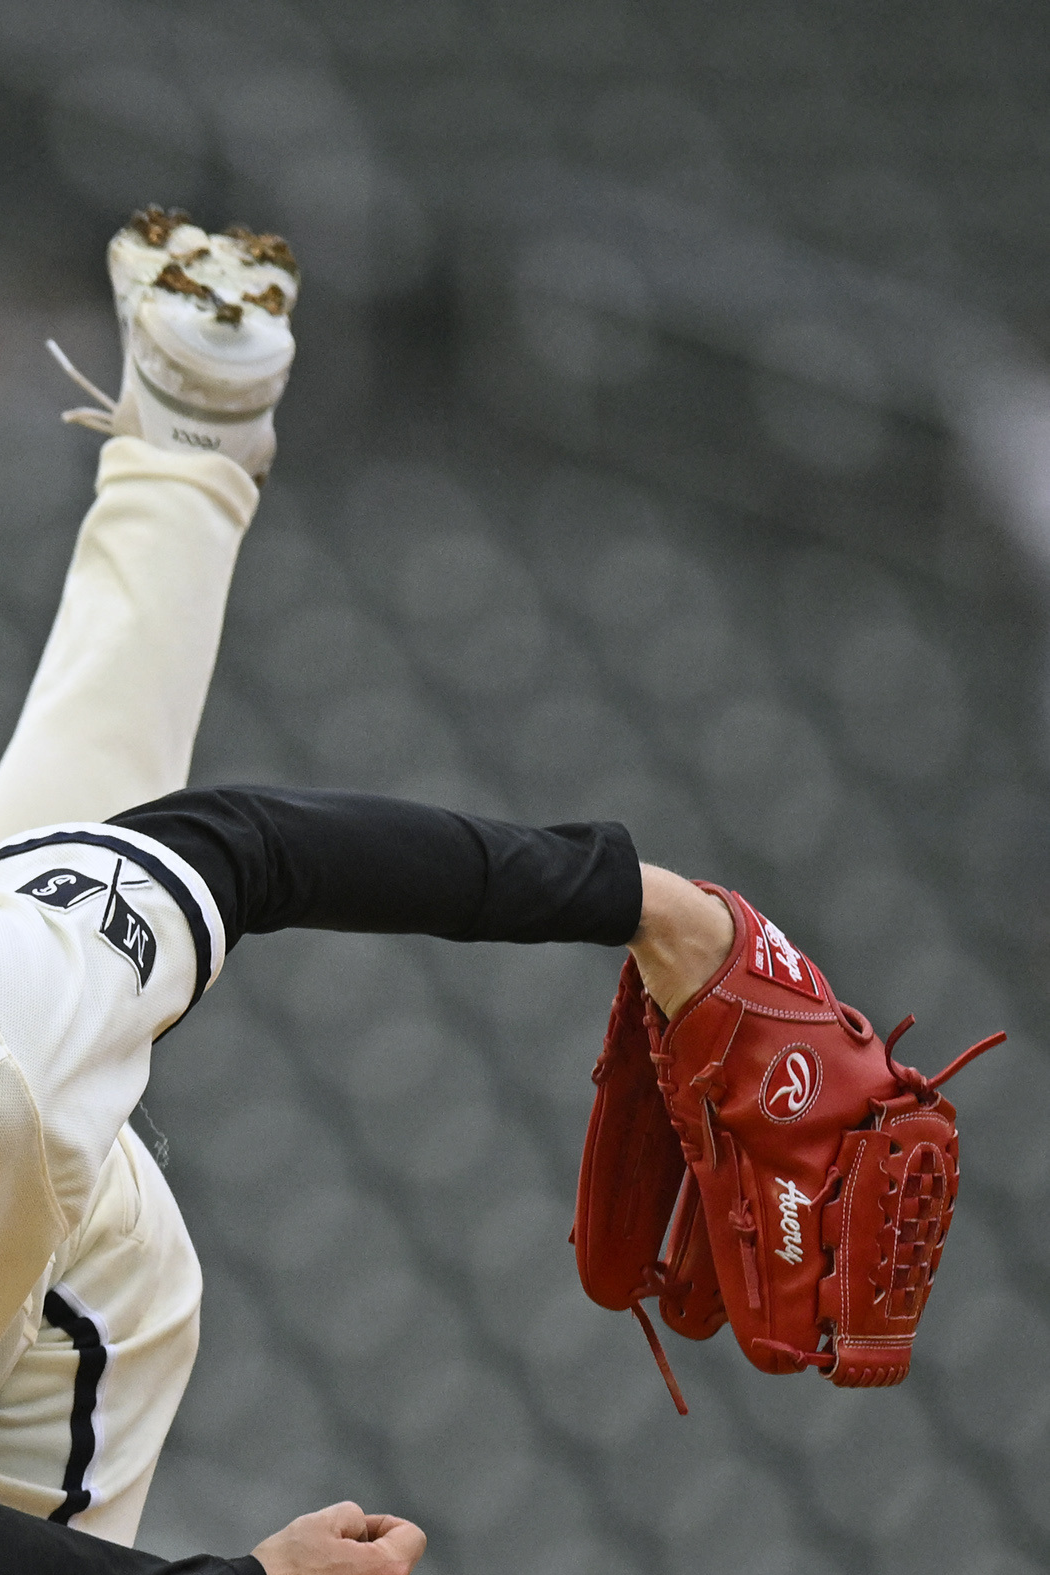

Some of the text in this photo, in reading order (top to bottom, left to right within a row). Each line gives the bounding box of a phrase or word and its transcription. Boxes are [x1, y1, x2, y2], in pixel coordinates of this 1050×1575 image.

[31, 873, 77, 897] S
[769, 1052, 811, 1112] R
[774, 1177, 812, 1265] Avery
